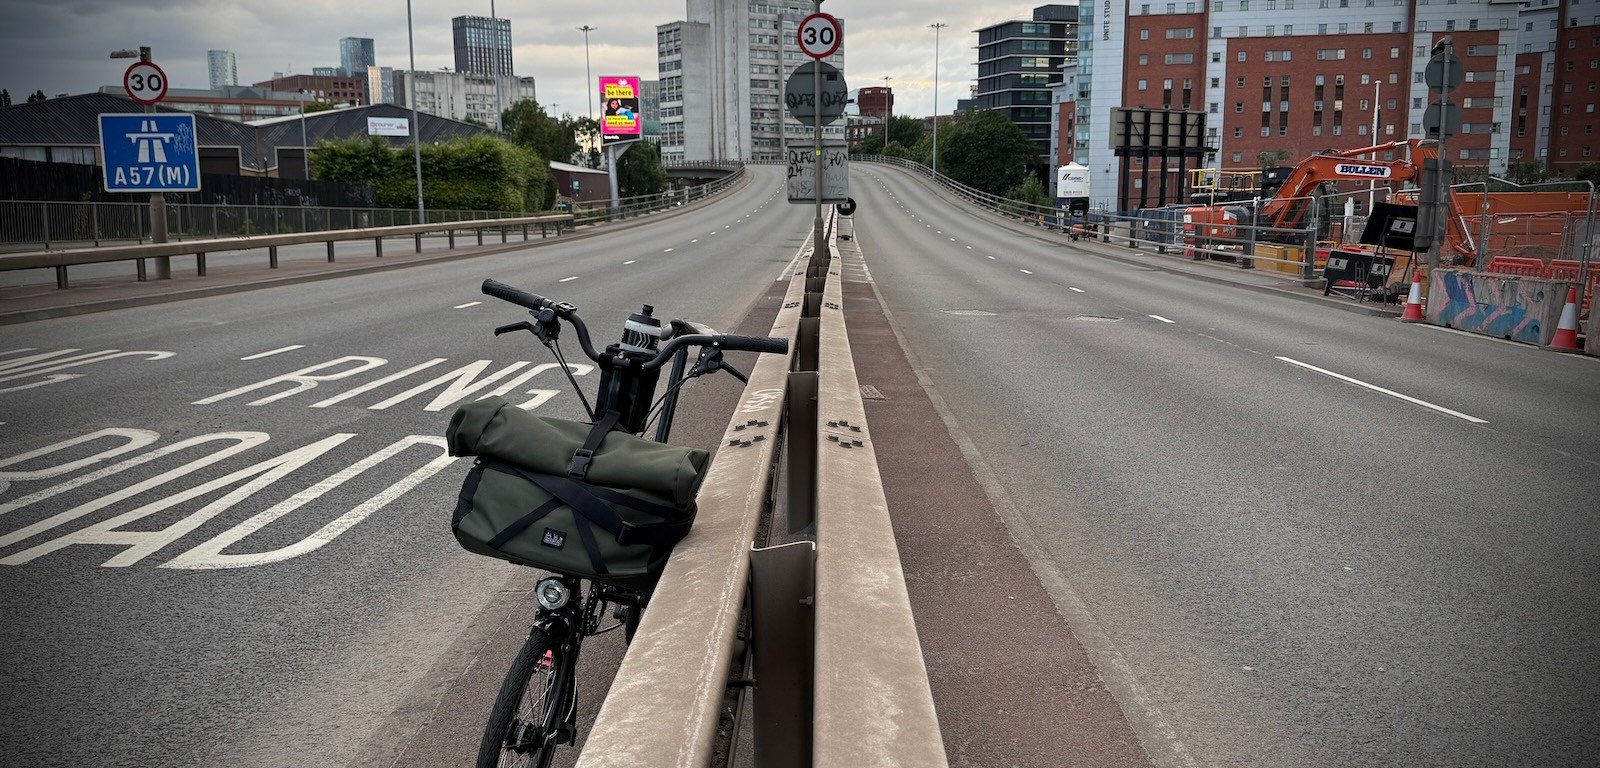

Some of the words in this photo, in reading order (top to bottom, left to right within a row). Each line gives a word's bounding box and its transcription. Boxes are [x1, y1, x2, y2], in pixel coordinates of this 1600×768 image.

[804, 27, 834, 45] 30
[130, 74, 162, 91] 30
[115, 164, 190, 186] A57(M)
[1340, 165, 1386, 176] BULLEN
[190, 355, 595, 412] RING
